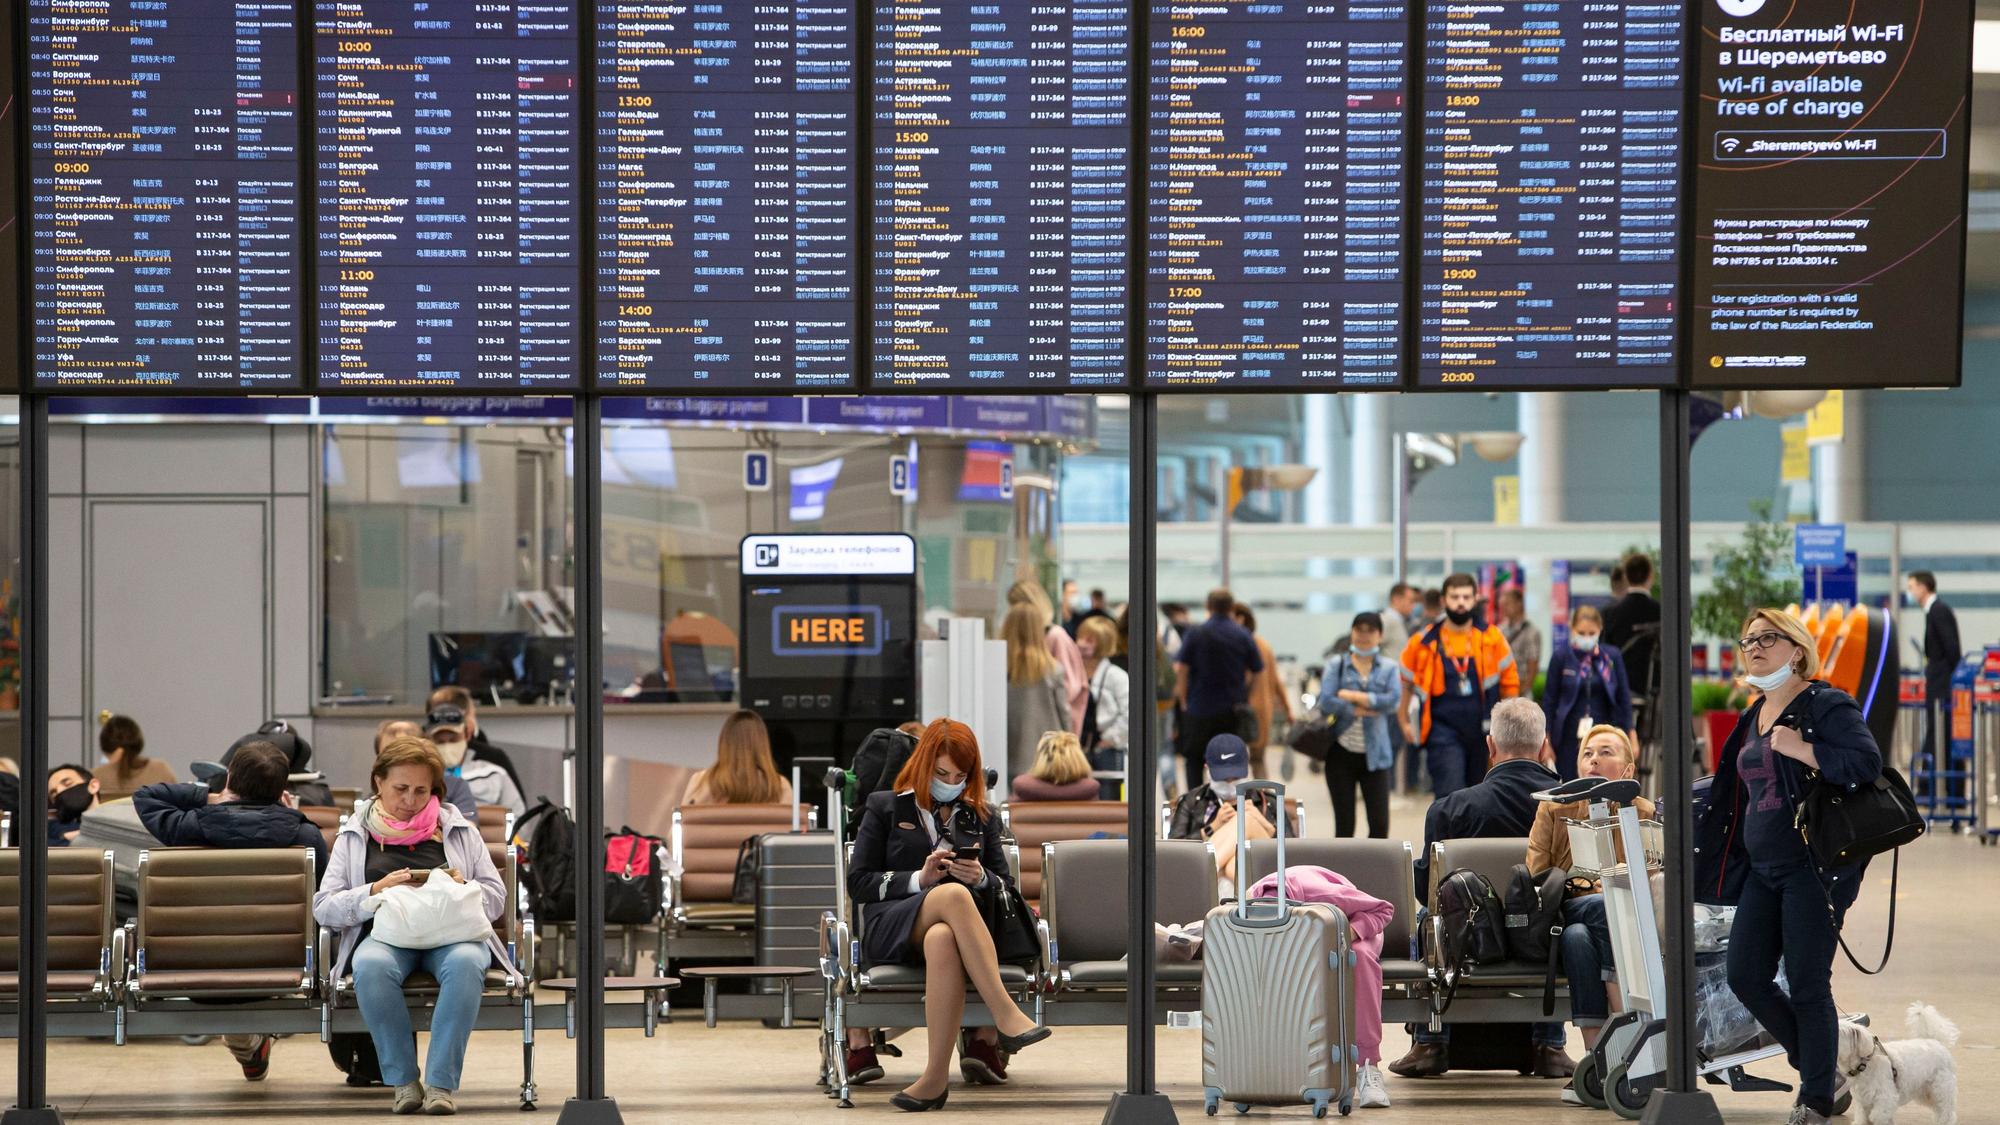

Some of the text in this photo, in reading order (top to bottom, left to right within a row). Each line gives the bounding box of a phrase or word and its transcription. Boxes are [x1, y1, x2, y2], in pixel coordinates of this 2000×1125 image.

[52, 17, 109, 25] Екатеринбург
[337, 21, 372, 29] Стамбул
[895, 24, 941, 32] Амстердам
[1172, 27, 1205, 36] 16:00
[1720, 24, 1904, 43] Бесплатный Wi-Fi
[52, 35, 77, 43] Анапа
[338, 42, 371, 52] 10:00
[618, 41, 665, 49] Ставрополь
[53, 54, 99, 62] Сыктывкар
[338, 57, 381, 65] Волгоград
[1720, 50, 1886, 68] в Шереметьево
[895, 59, 952, 68] Магнитогорск
[895, 77, 936, 85] Астрахань
[1718, 76, 1863, 93] Wi-fi available
[338, 92, 379, 100] Мин.Воды
[1447, 96, 1479, 105] 18:00
[619, 97, 651, 106] 13:00
[1717, 99, 1864, 118] free of charge
[338, 109, 392, 118] Калининград
[54, 125, 102, 133] Ставрополь
[367, 127, 401, 135] Уренгой
[618, 128, 663, 136] Геленджик
[896, 133, 928, 142] 15:00
[54, 142, 125, 151] Санкт-Петербург
[1745, 139, 1877, 154] _Sheremetyevo Wi-Fi
[55, 163, 89, 173] 09:00
[339, 162, 378, 171] Белгород
[55, 178, 102, 186] Геленджик
[55, 195, 120, 204] Ростов-на-Дону
[339, 198, 409, 206] Санкт-Петербург
[895, 199, 921, 207] Пермь
[56, 213, 113, 221] Симферополь
[894, 217, 936, 225] Мурманск
[1714, 219, 1869, 229] Нужна регистрация по номеру
[619, 233, 671, 242] Калининград
[1714, 231, 1855, 241] телефона это требование
[56, 248, 110, 257] Новосибирск
[1713, 244, 1867, 253] Постановления Правительства
[618, 251, 649, 259] Лондон
[1730, 257, 1760, 265] №785
[1777, 257, 1829, 265] 12.08.2014
[340, 271, 374, 280] 11:00
[894, 268, 940, 276] Франкфурт
[1443, 270, 1476, 279] 19:00
[57, 283, 103, 292] Геленджик
[1169, 288, 1201, 297] 17:00
[1712, 294, 1736, 303] User
[1737, 294, 1797, 305] registration
[1799, 294, 1821, 302] with
[1832, 294, 1857, 302] valid
[57, 301, 102, 310] Краснодар
[340, 302, 385, 311] Краснодар
[619, 306, 652, 315] 14:00
[1711, 307, 1858, 319] phone number is required by
[340, 320, 397, 328] Екатеринбург
[894, 320, 933, 328] Оренбург
[1711, 320, 1873, 329] the law of the Russian Federation
[57, 336, 119, 344] Горно-Алтайск
[619, 337, 661, 345] Барселона
[619, 354, 653, 363] Стамбул
[58, 371, 103, 379] Краснодар
[894, 372, 950, 380] Симферополь
[1441, 373, 1475, 382] 20:00
[753, 460, 761, 481] 1
[894, 461, 905, 485] 2
[790, 619, 864, 642] HERE
